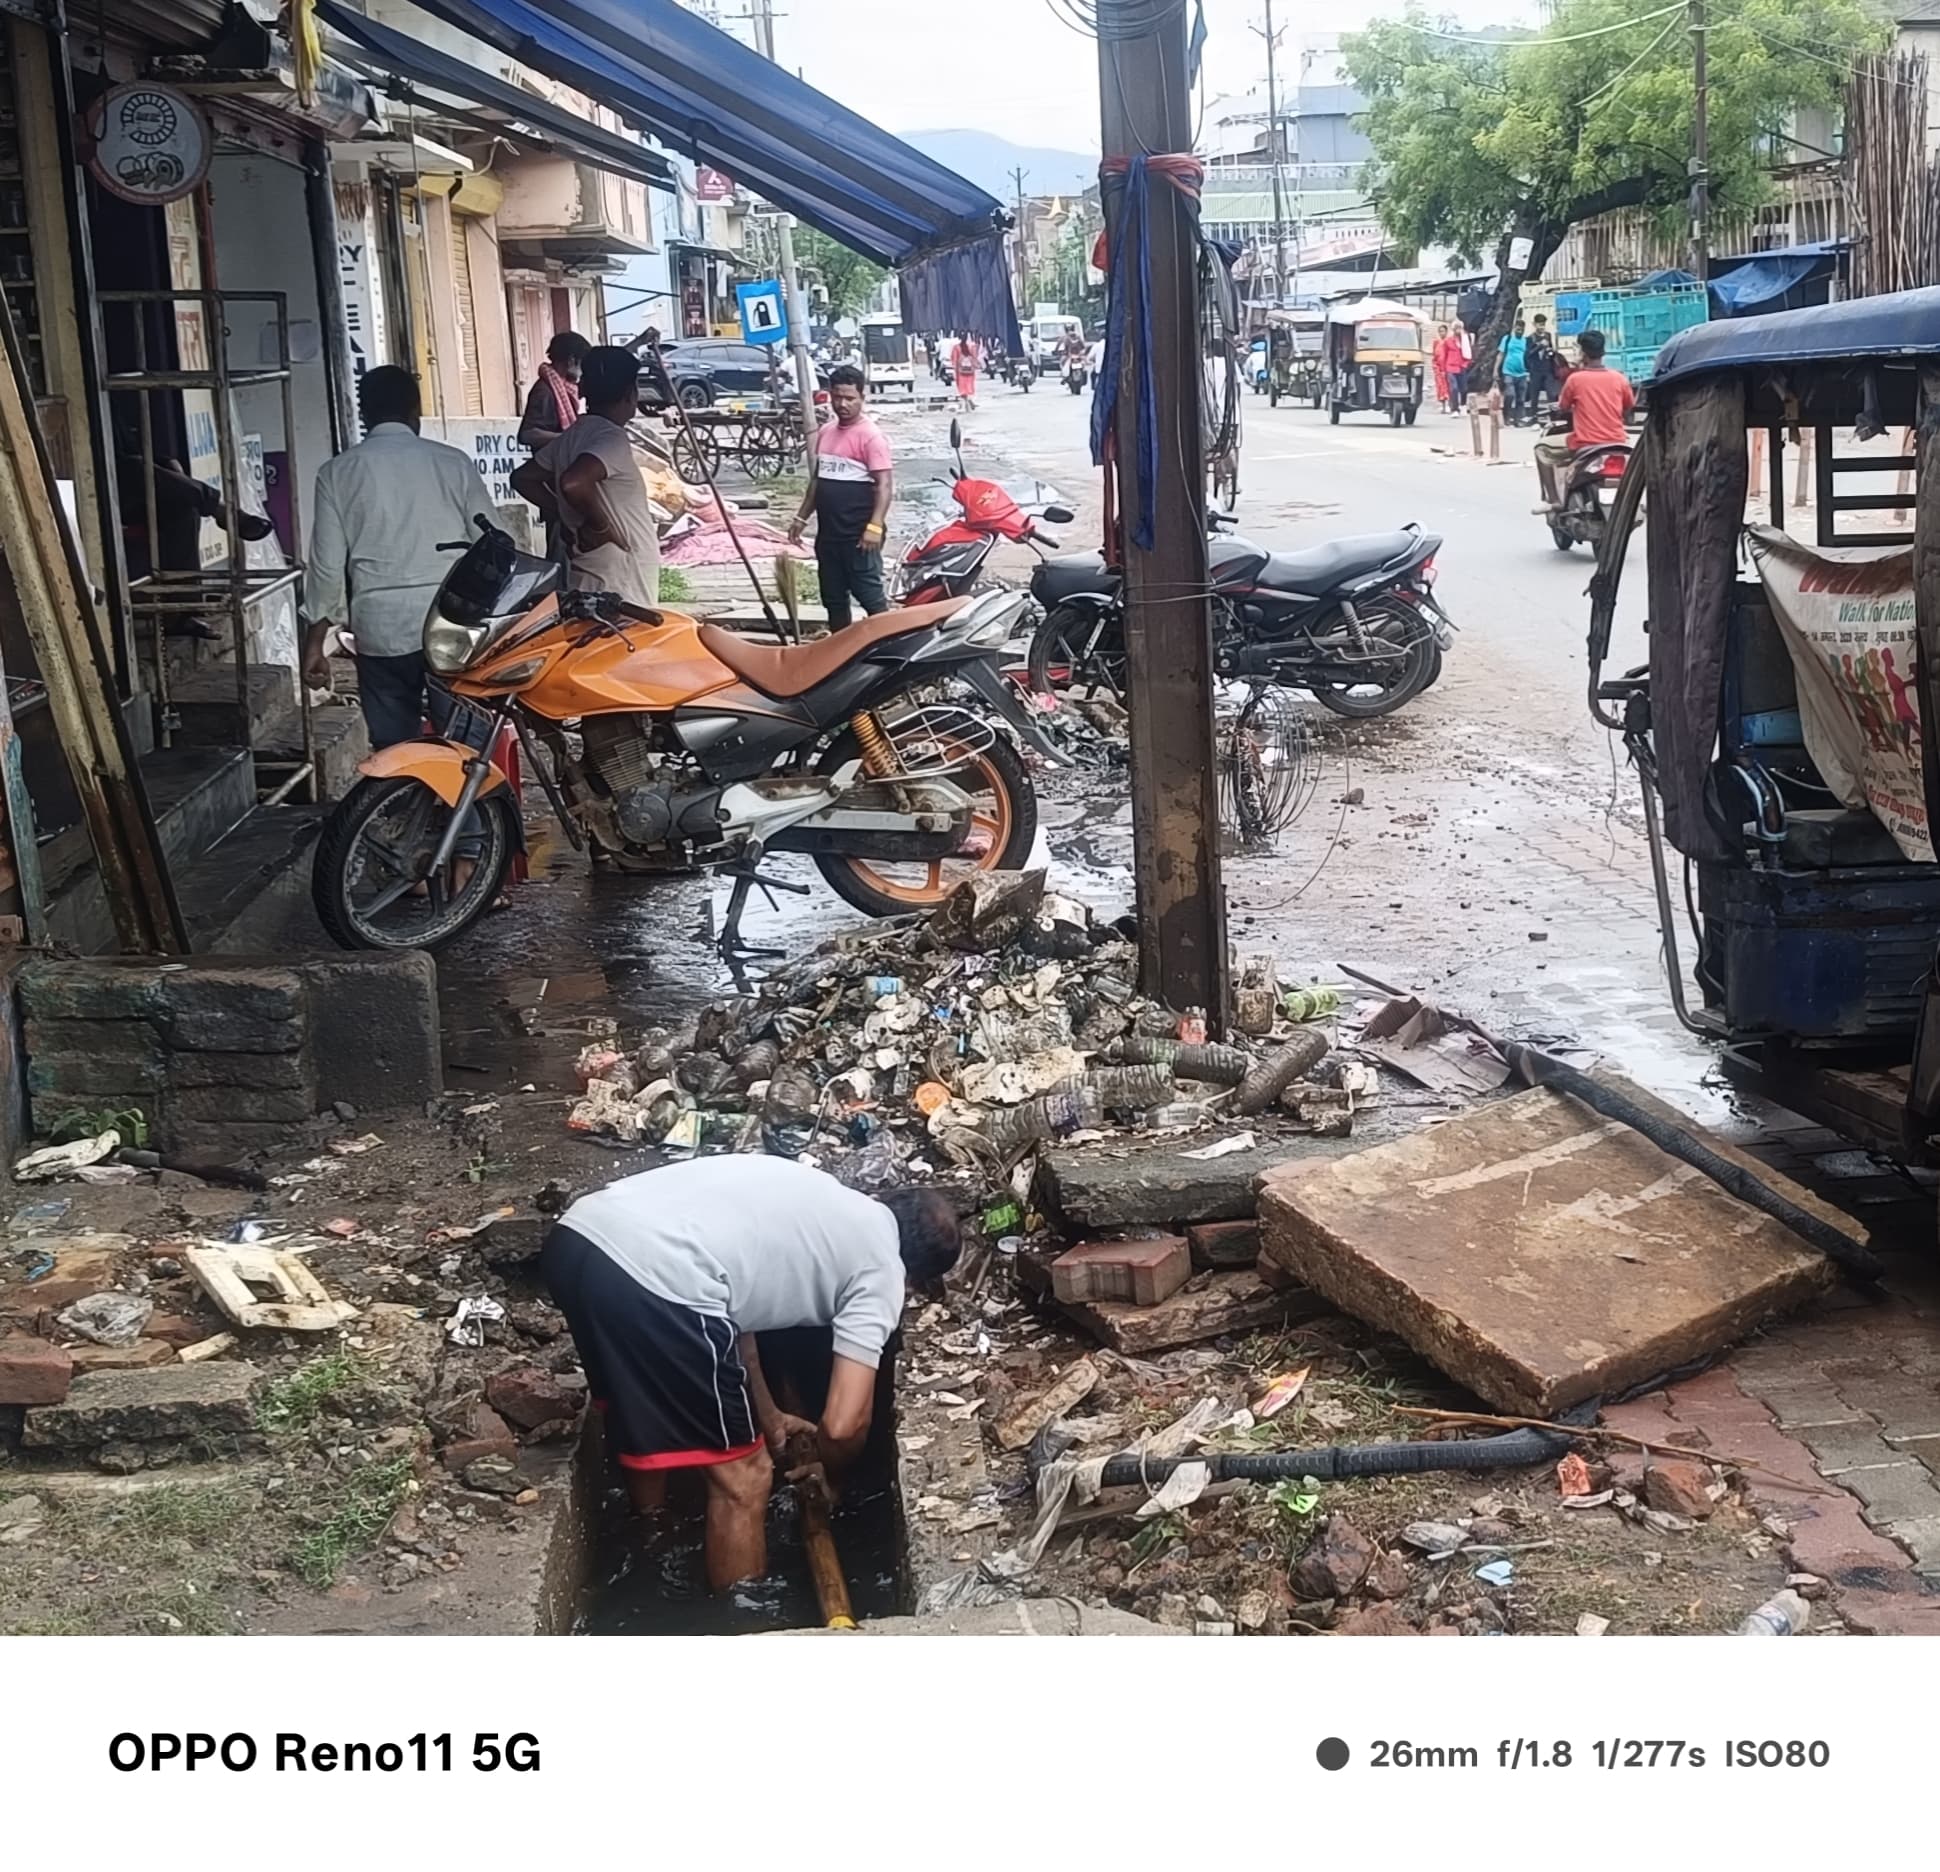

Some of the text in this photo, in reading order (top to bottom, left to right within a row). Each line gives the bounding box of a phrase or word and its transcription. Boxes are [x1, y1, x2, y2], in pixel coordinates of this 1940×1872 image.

[475, 434, 502, 453] DRY
[1839, 599, 1915, 623] Walk for Natio
